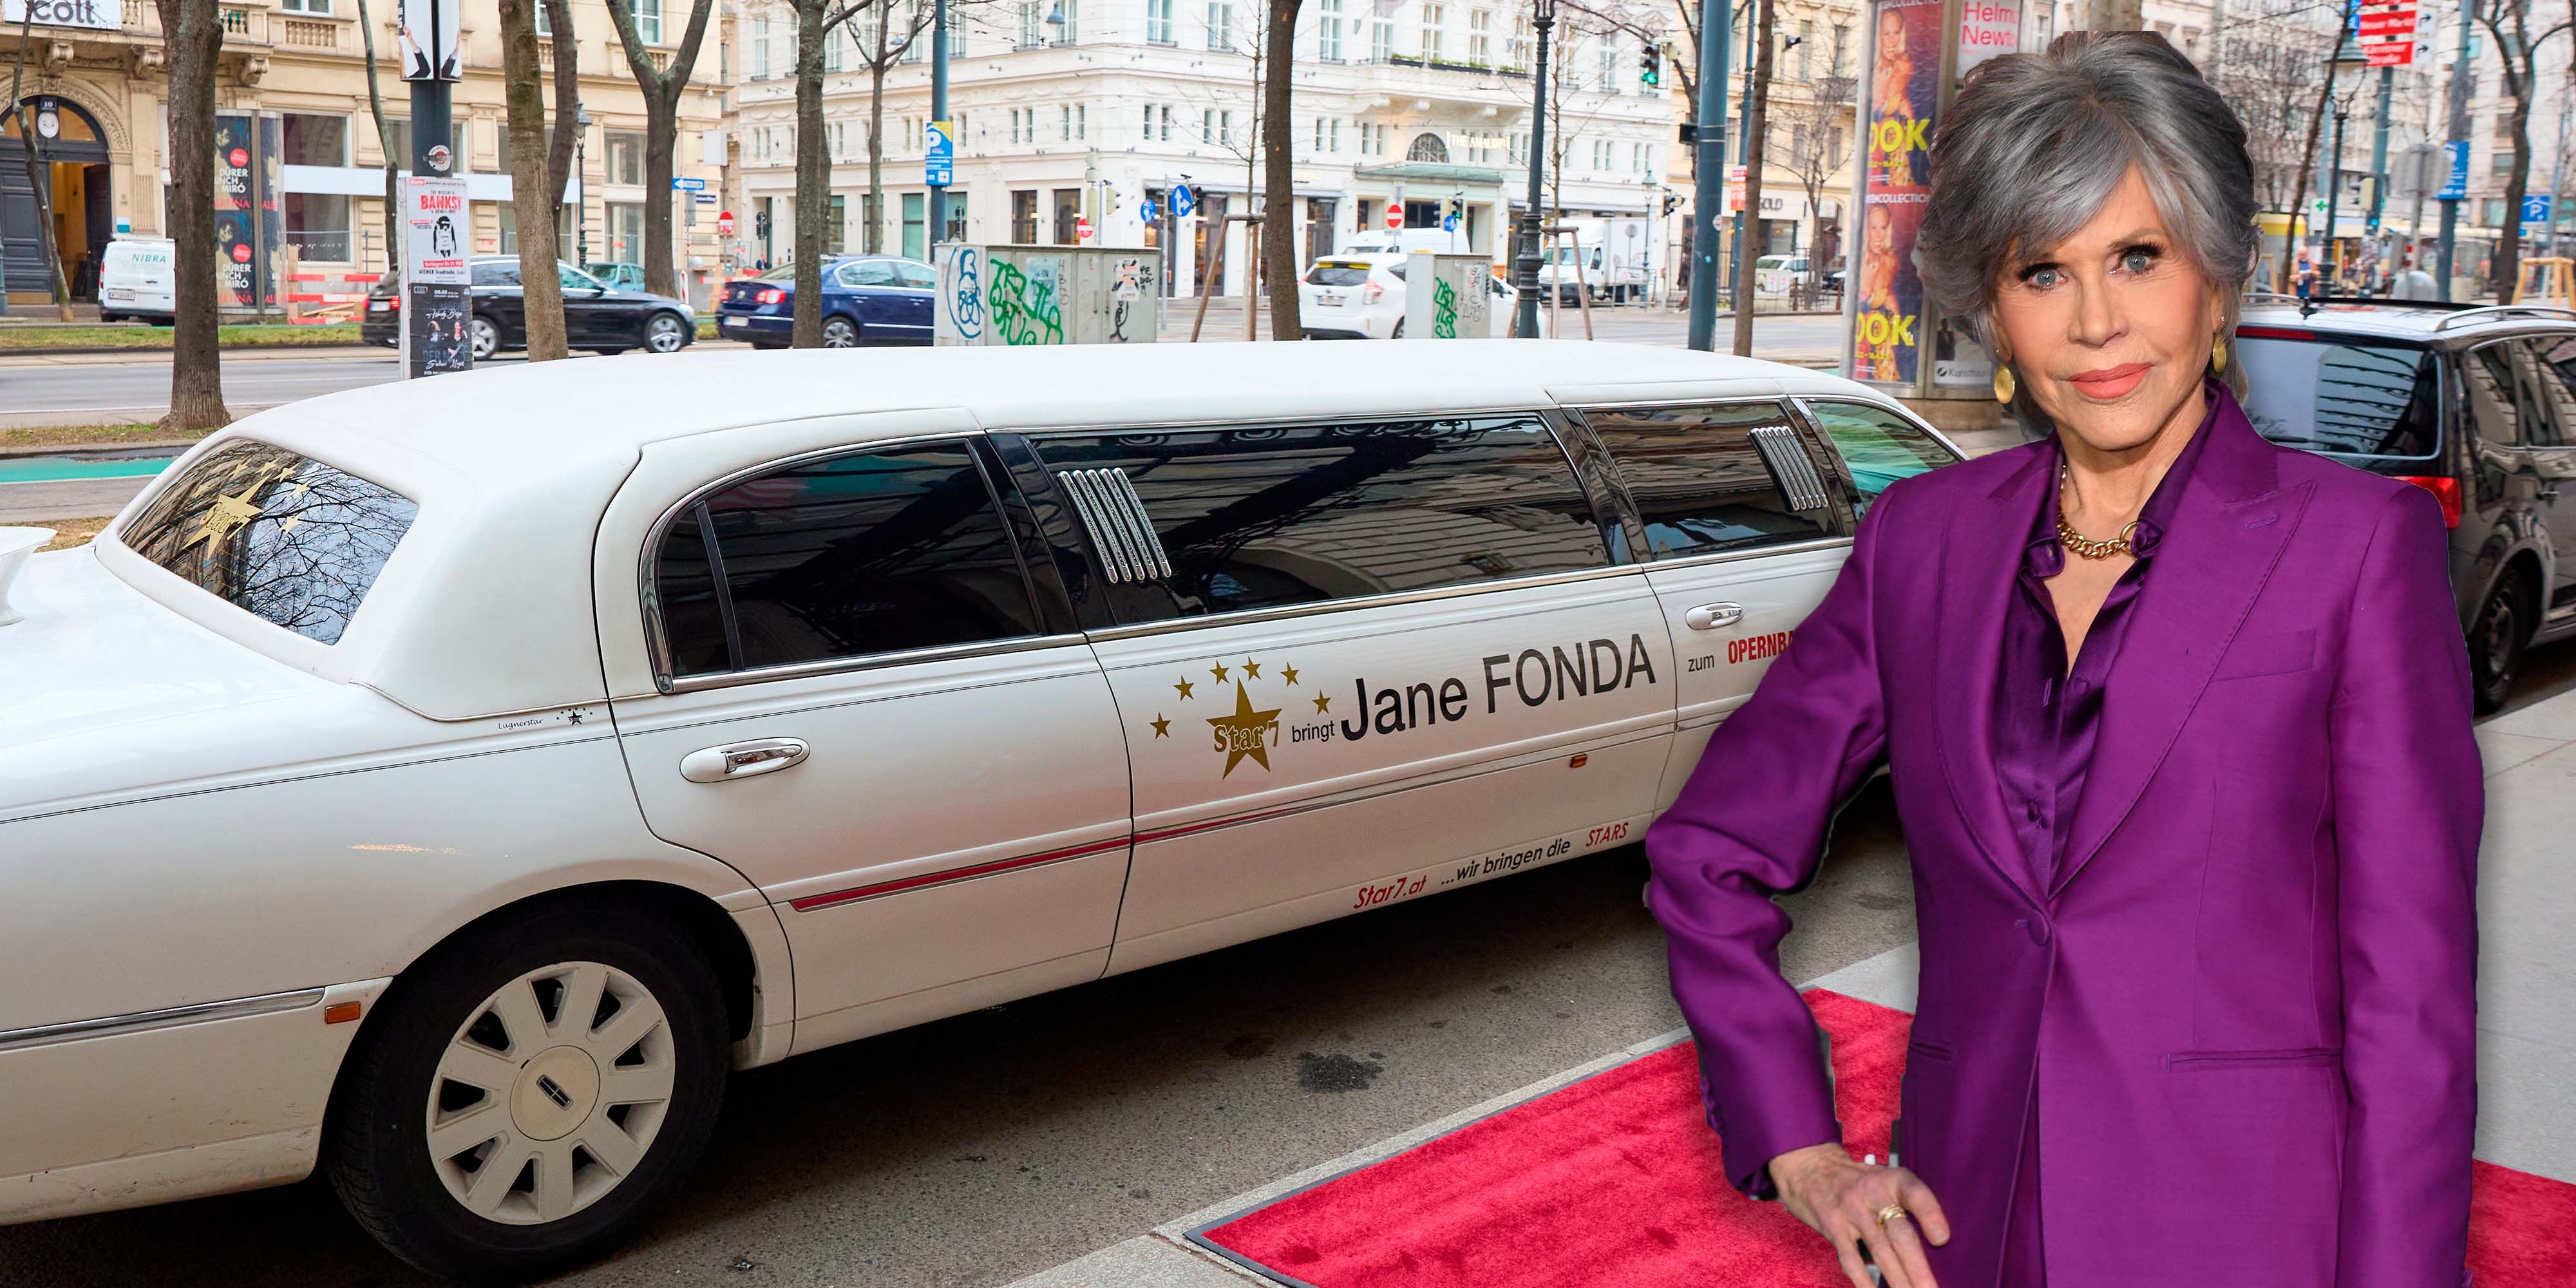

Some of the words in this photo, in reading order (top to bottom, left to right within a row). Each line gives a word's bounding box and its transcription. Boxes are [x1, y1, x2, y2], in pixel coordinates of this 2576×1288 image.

[421, 194, 462, 211] BANKSY
[132, 254, 166, 263] NIBRA
[1688, 653, 1715, 672] zum
[1292, 720, 1336, 743] bringt
[1341, 677, 1468, 741] Jane
[1482, 634, 1656, 714] FONDA
[498, 718, 544, 730] Lugnerstar
[1353, 875, 1428, 909] Star7.at
[1482, 846, 1543, 875] bringen
[1547, 838, 1571, 857] die
[1586, 822, 1629, 847] STARS
